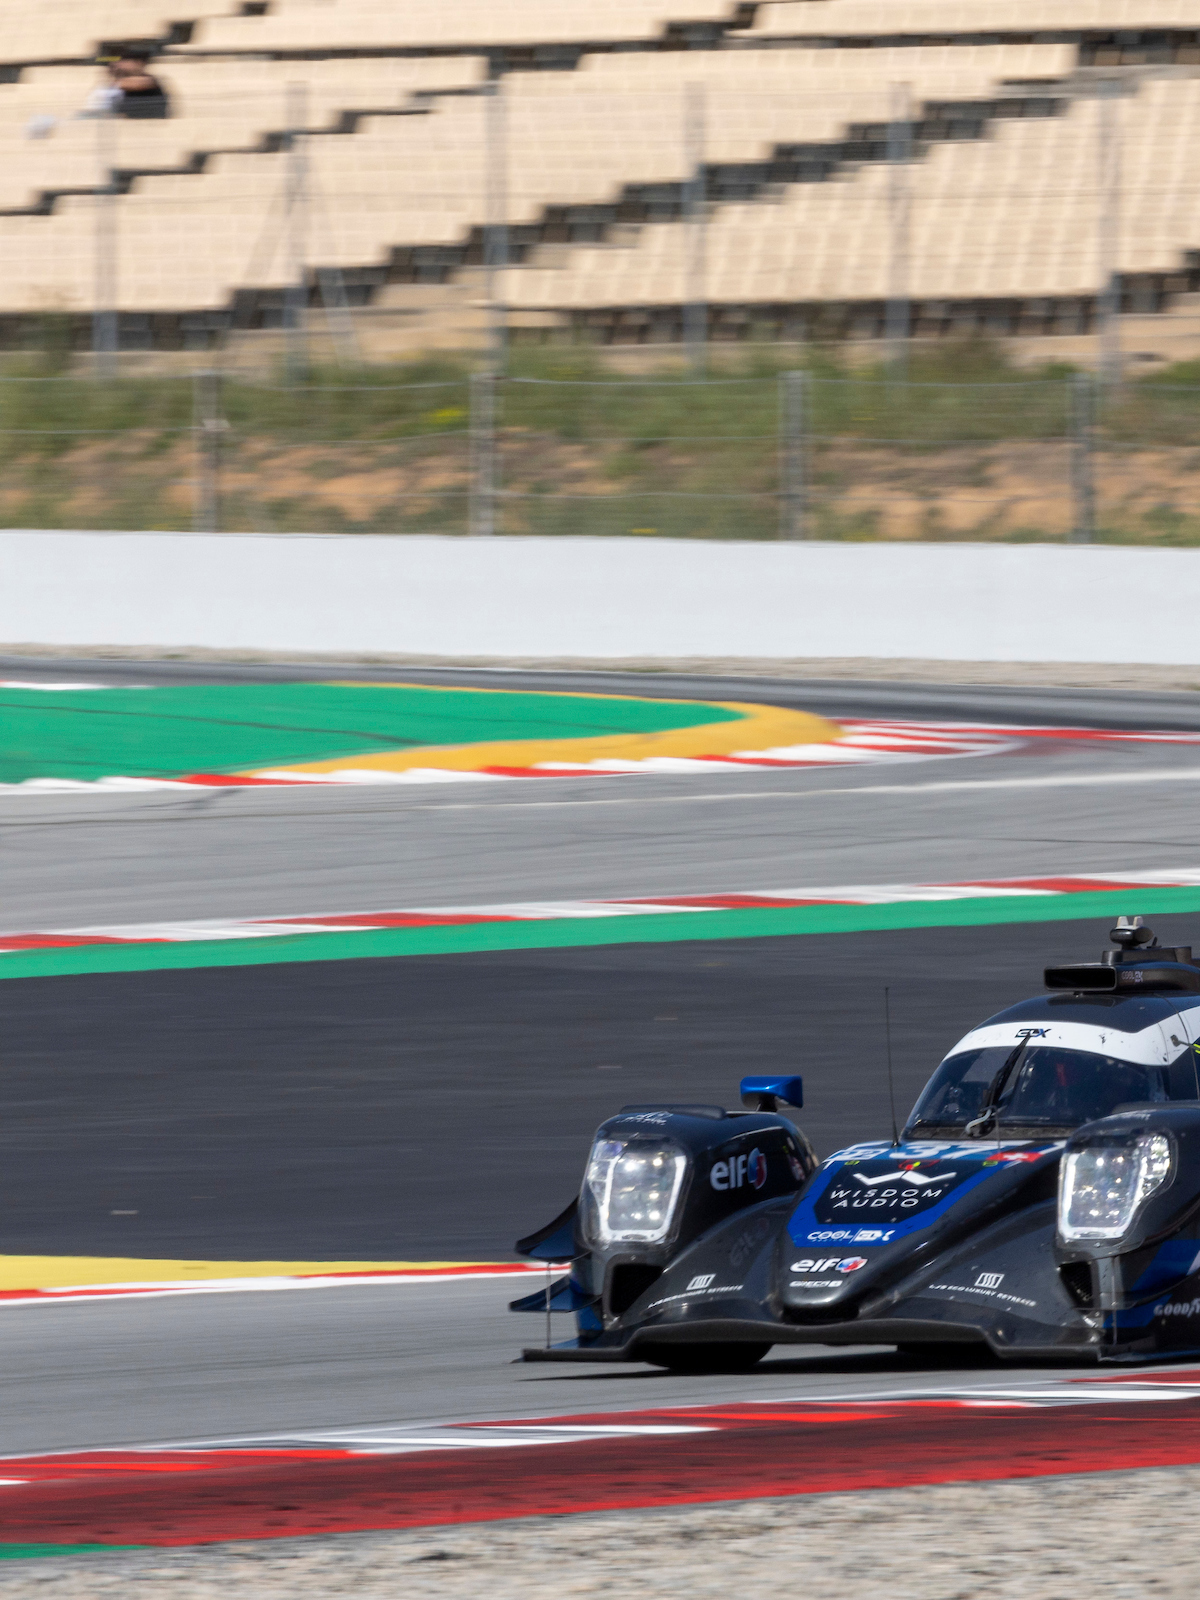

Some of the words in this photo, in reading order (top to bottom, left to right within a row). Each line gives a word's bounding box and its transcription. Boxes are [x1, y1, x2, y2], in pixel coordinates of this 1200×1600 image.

[889, 1144, 1005, 1160] 37
[709, 1153, 748, 1191] elf
[830, 1188, 942, 1199] WISDOM
[832, 1198, 919, 1209] AUDIO
[807, 1230, 853, 1240] COOL
[790, 1258, 841, 1273] elf
